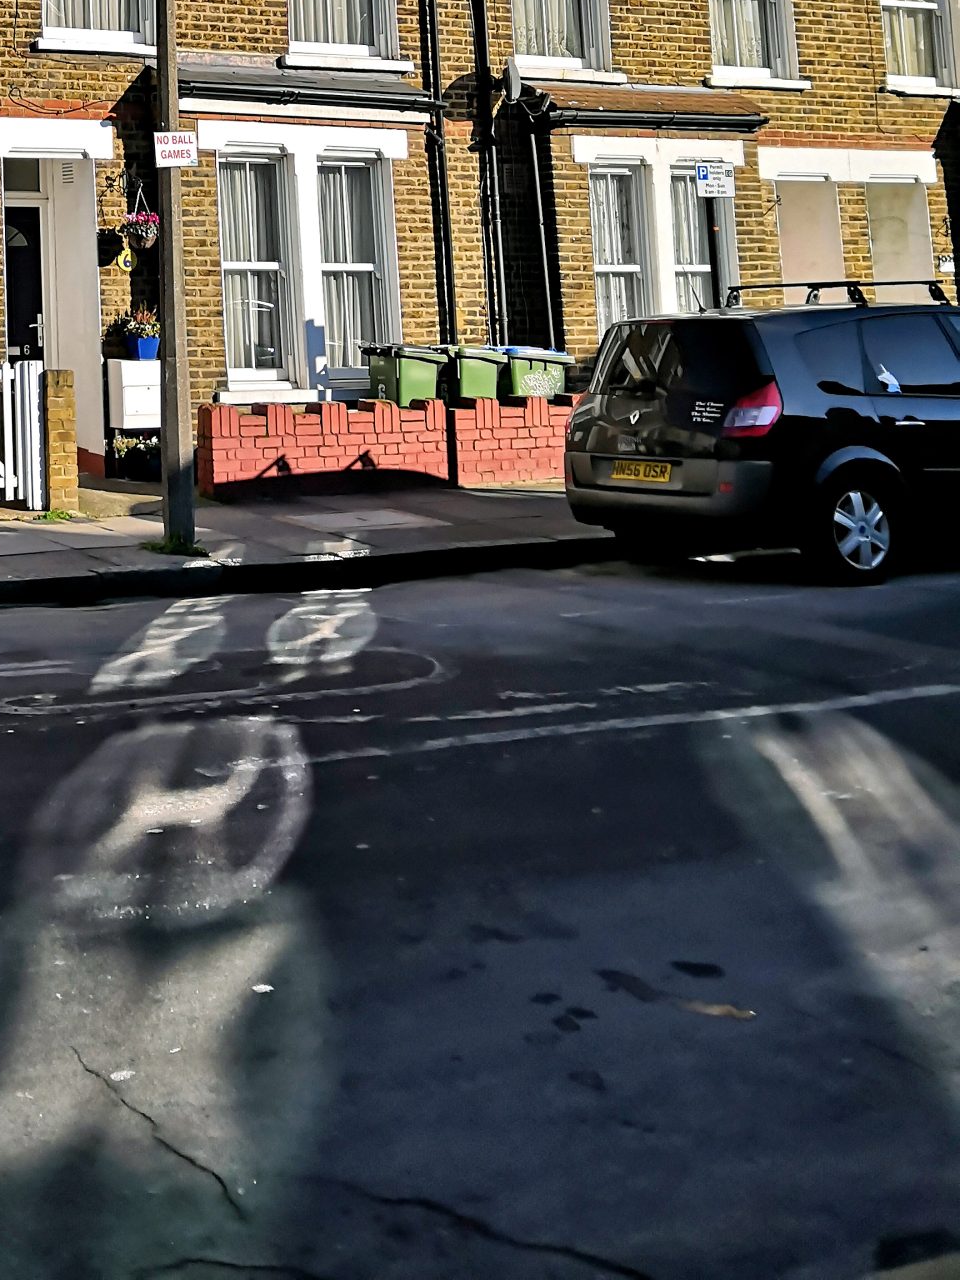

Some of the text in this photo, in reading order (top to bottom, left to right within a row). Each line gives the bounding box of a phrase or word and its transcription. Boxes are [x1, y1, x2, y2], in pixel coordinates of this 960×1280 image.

[156, 135, 194, 145] NO BALL
[160, 149, 192, 159] GAMES
[123, 253, 132, 268] 6
[23, 344, 30, 355] 6
